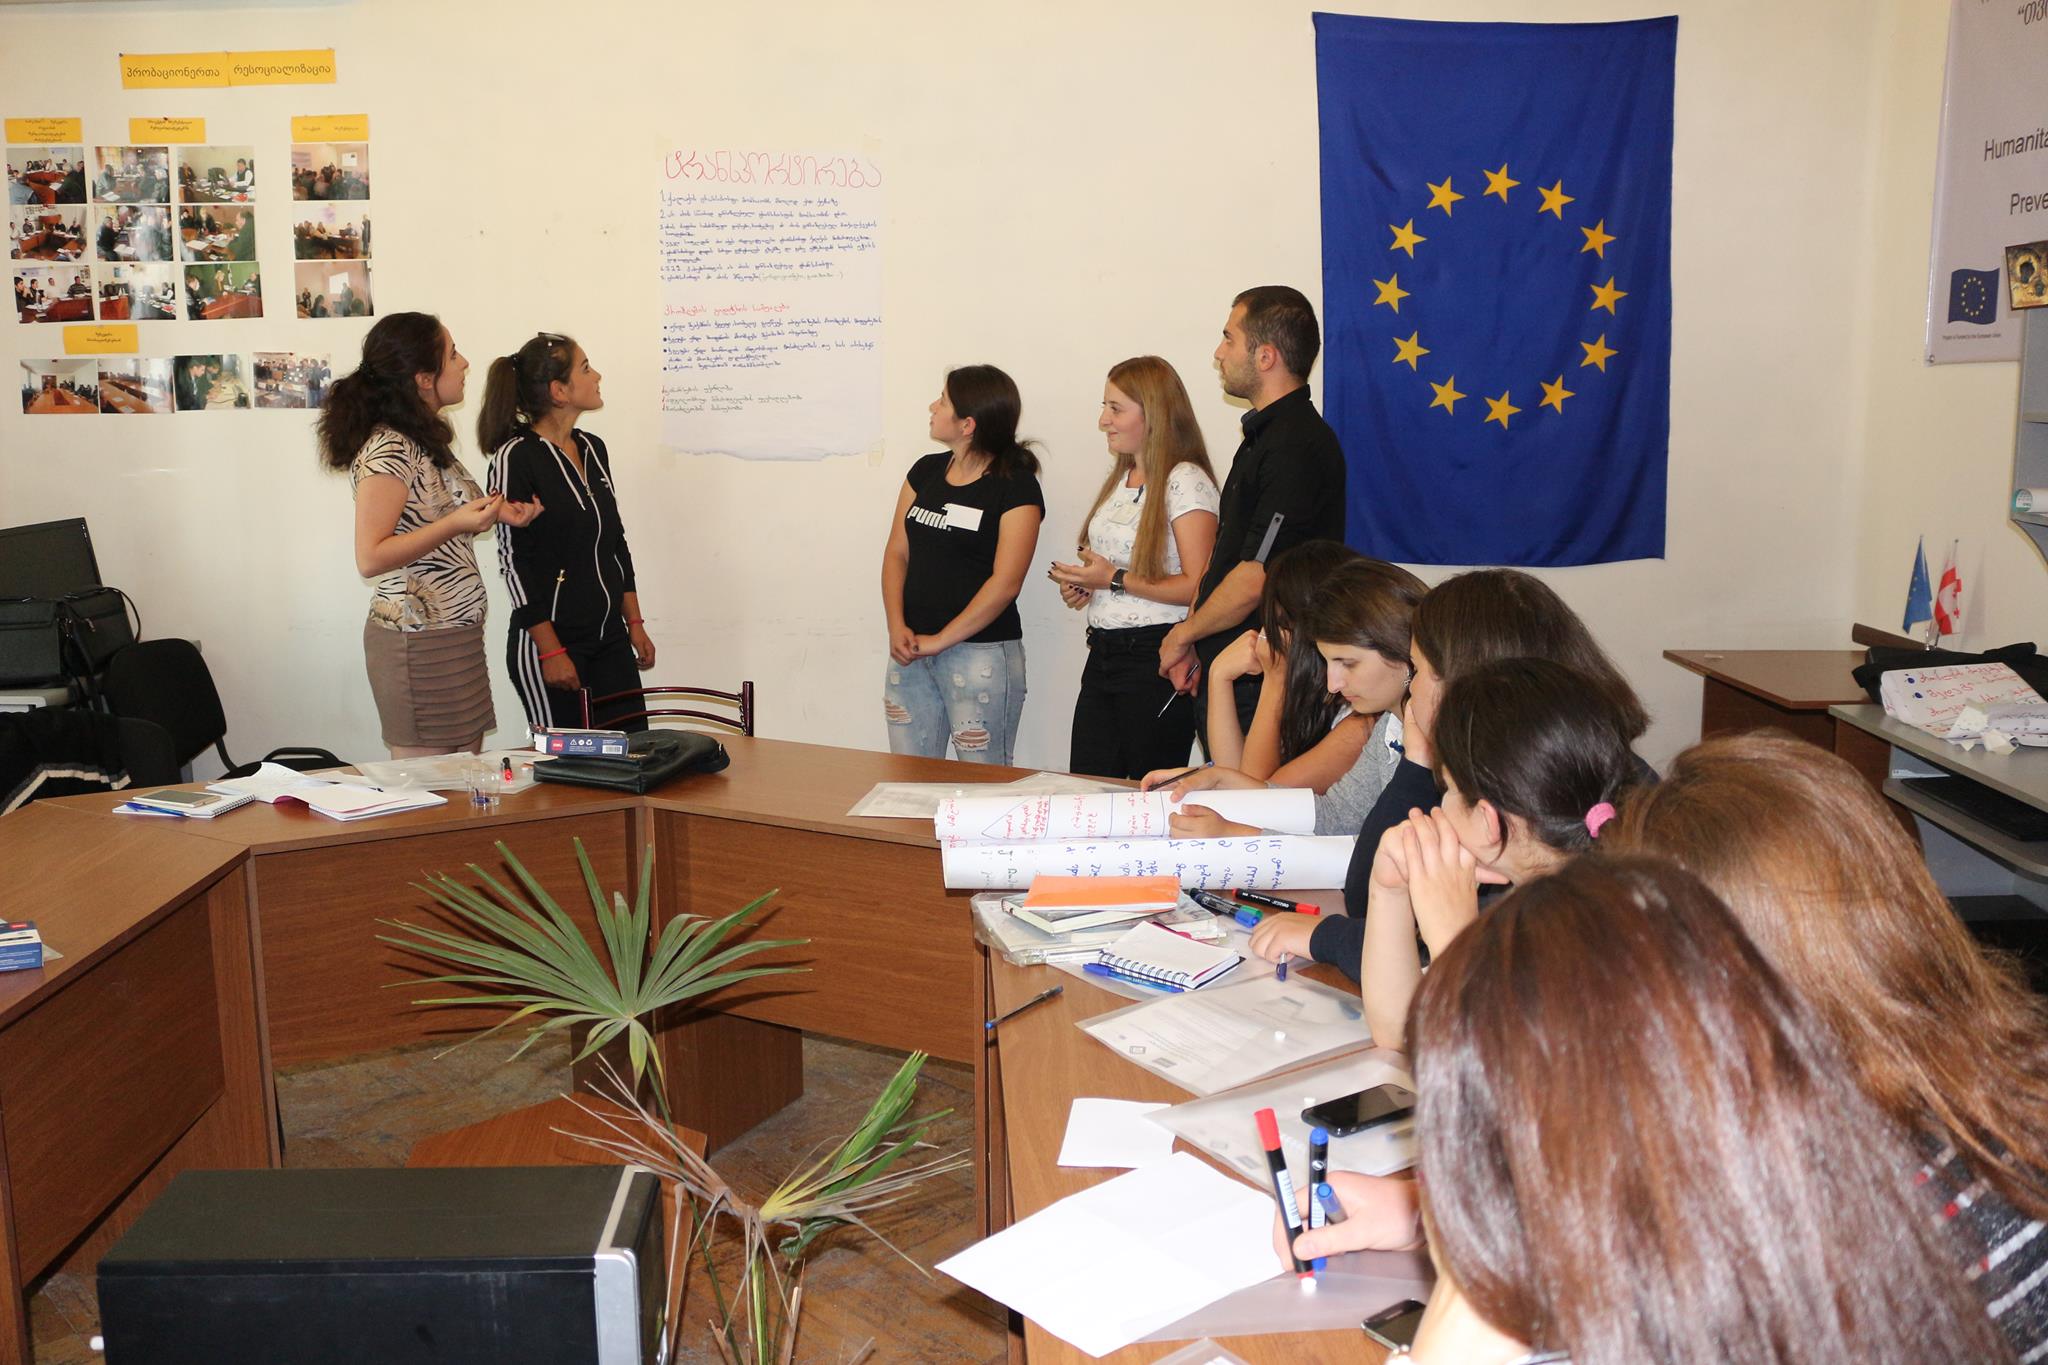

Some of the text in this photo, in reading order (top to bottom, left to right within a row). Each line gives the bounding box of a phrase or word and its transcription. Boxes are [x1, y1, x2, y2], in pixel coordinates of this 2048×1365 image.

[127, 63, 331, 79] პრობაციონერთა რესოციალიზაცია
[665, 150, 882, 188] ტრანსპორტირება
[907, 505, 948, 530] PUMA
